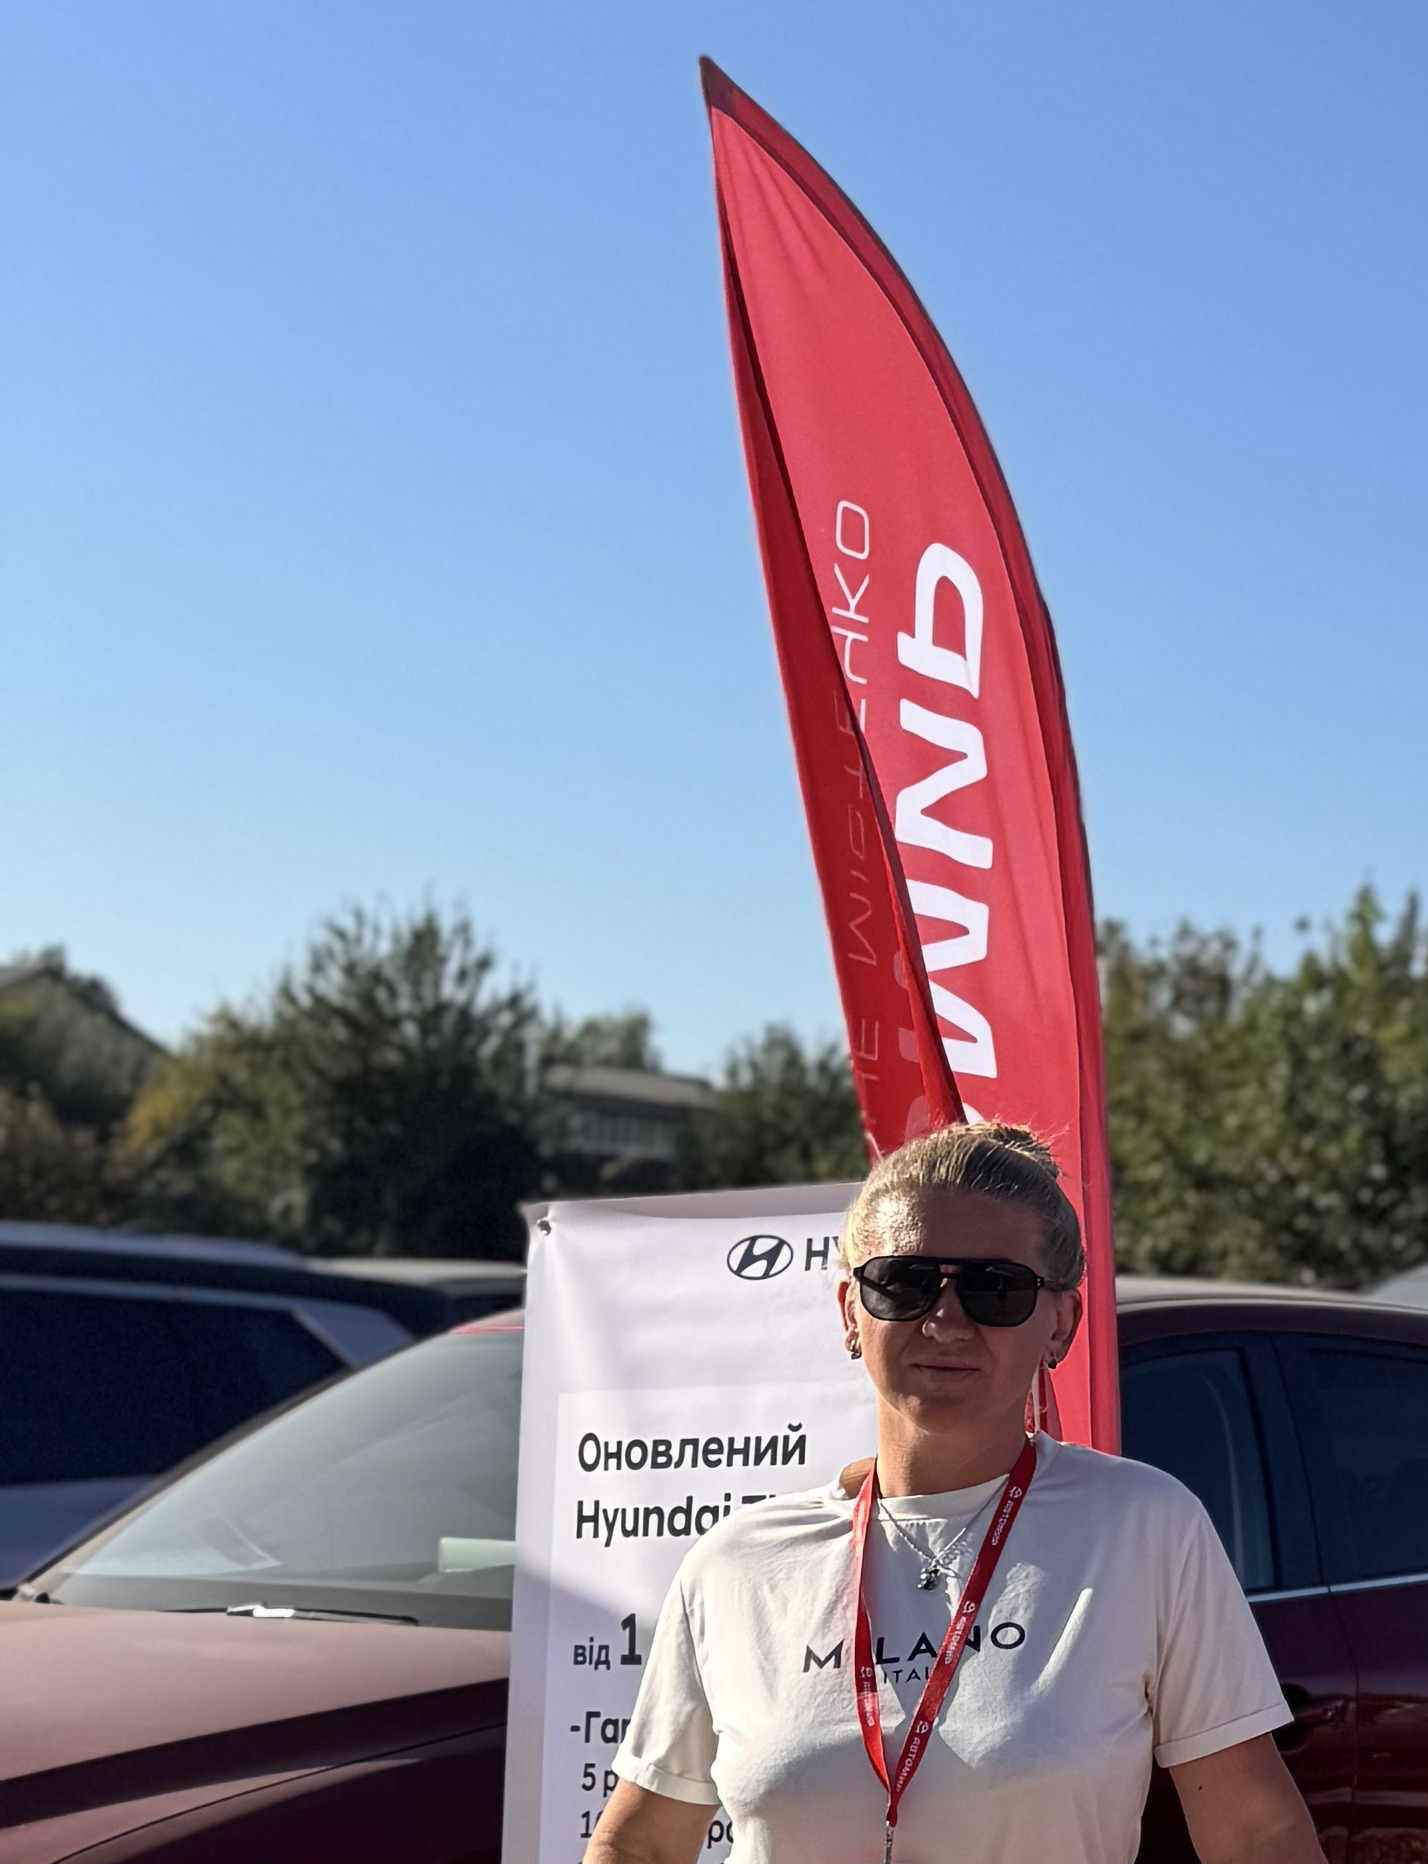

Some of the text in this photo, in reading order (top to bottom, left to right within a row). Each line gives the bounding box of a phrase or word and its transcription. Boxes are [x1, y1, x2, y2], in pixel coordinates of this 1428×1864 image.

[578, 1422, 807, 1472] Оновлений
[573, 1636, 611, 1671] від
[581, 1762, 596, 1791] 5
